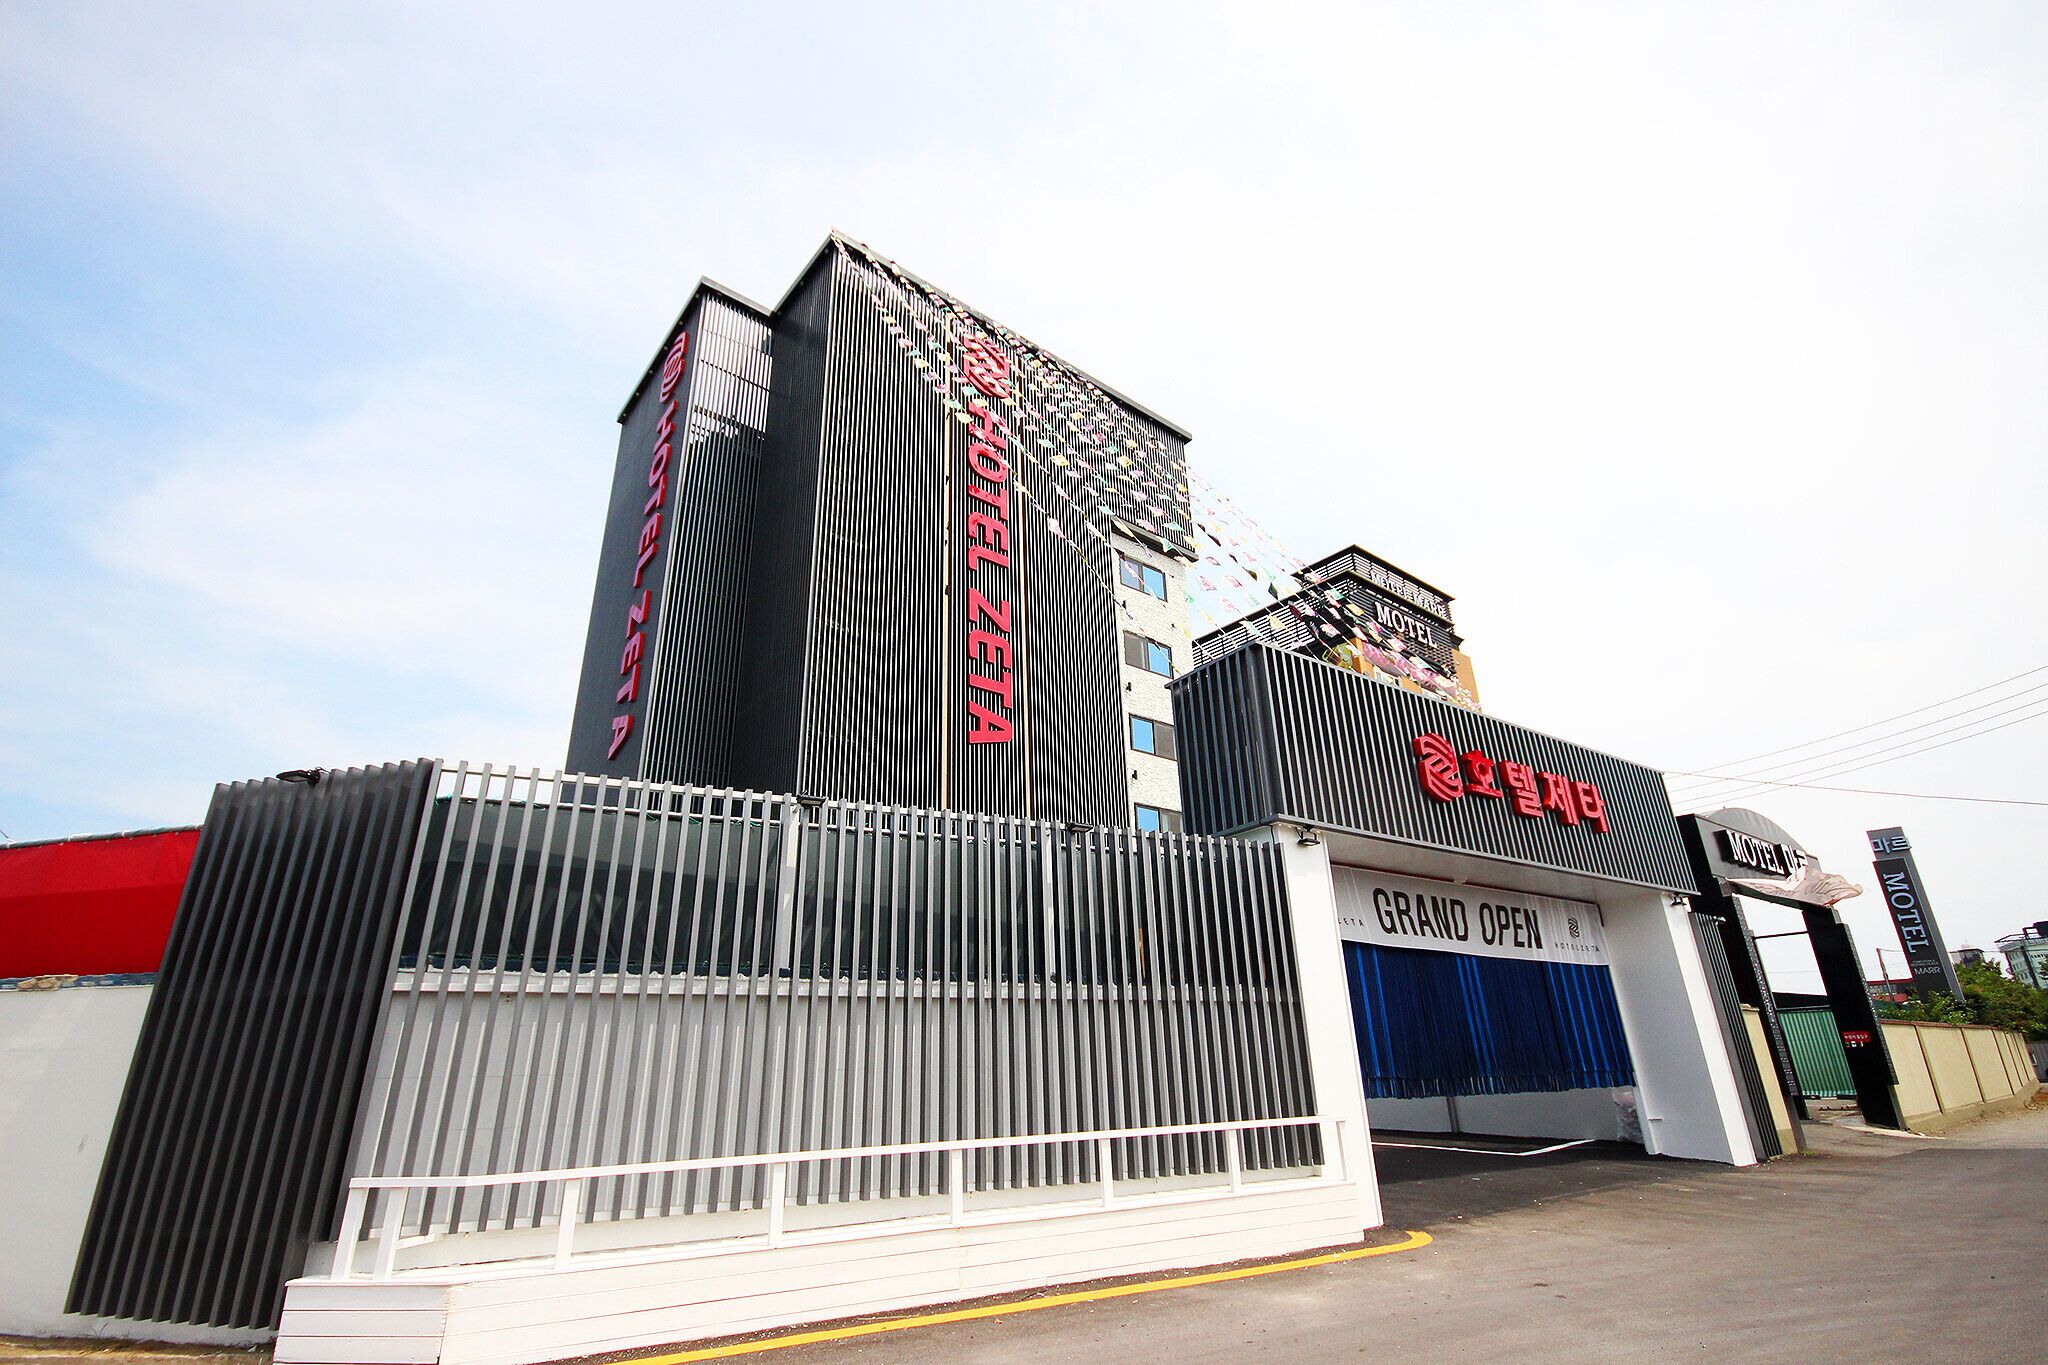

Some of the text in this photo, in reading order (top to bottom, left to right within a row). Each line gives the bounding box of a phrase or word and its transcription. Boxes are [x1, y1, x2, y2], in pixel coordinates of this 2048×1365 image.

[607, 399, 678, 760] HOTEL ZETA
[968, 399, 1013, 744] HOTEL ZETA
[1374, 600, 1438, 649] MOTEL
[1726, 829, 1785, 875] MOTEL
[1373, 887, 1543, 950] GRAND OPEN
[1883, 871, 1930, 953] MOTEL
[1914, 966, 1941, 975] MARR
